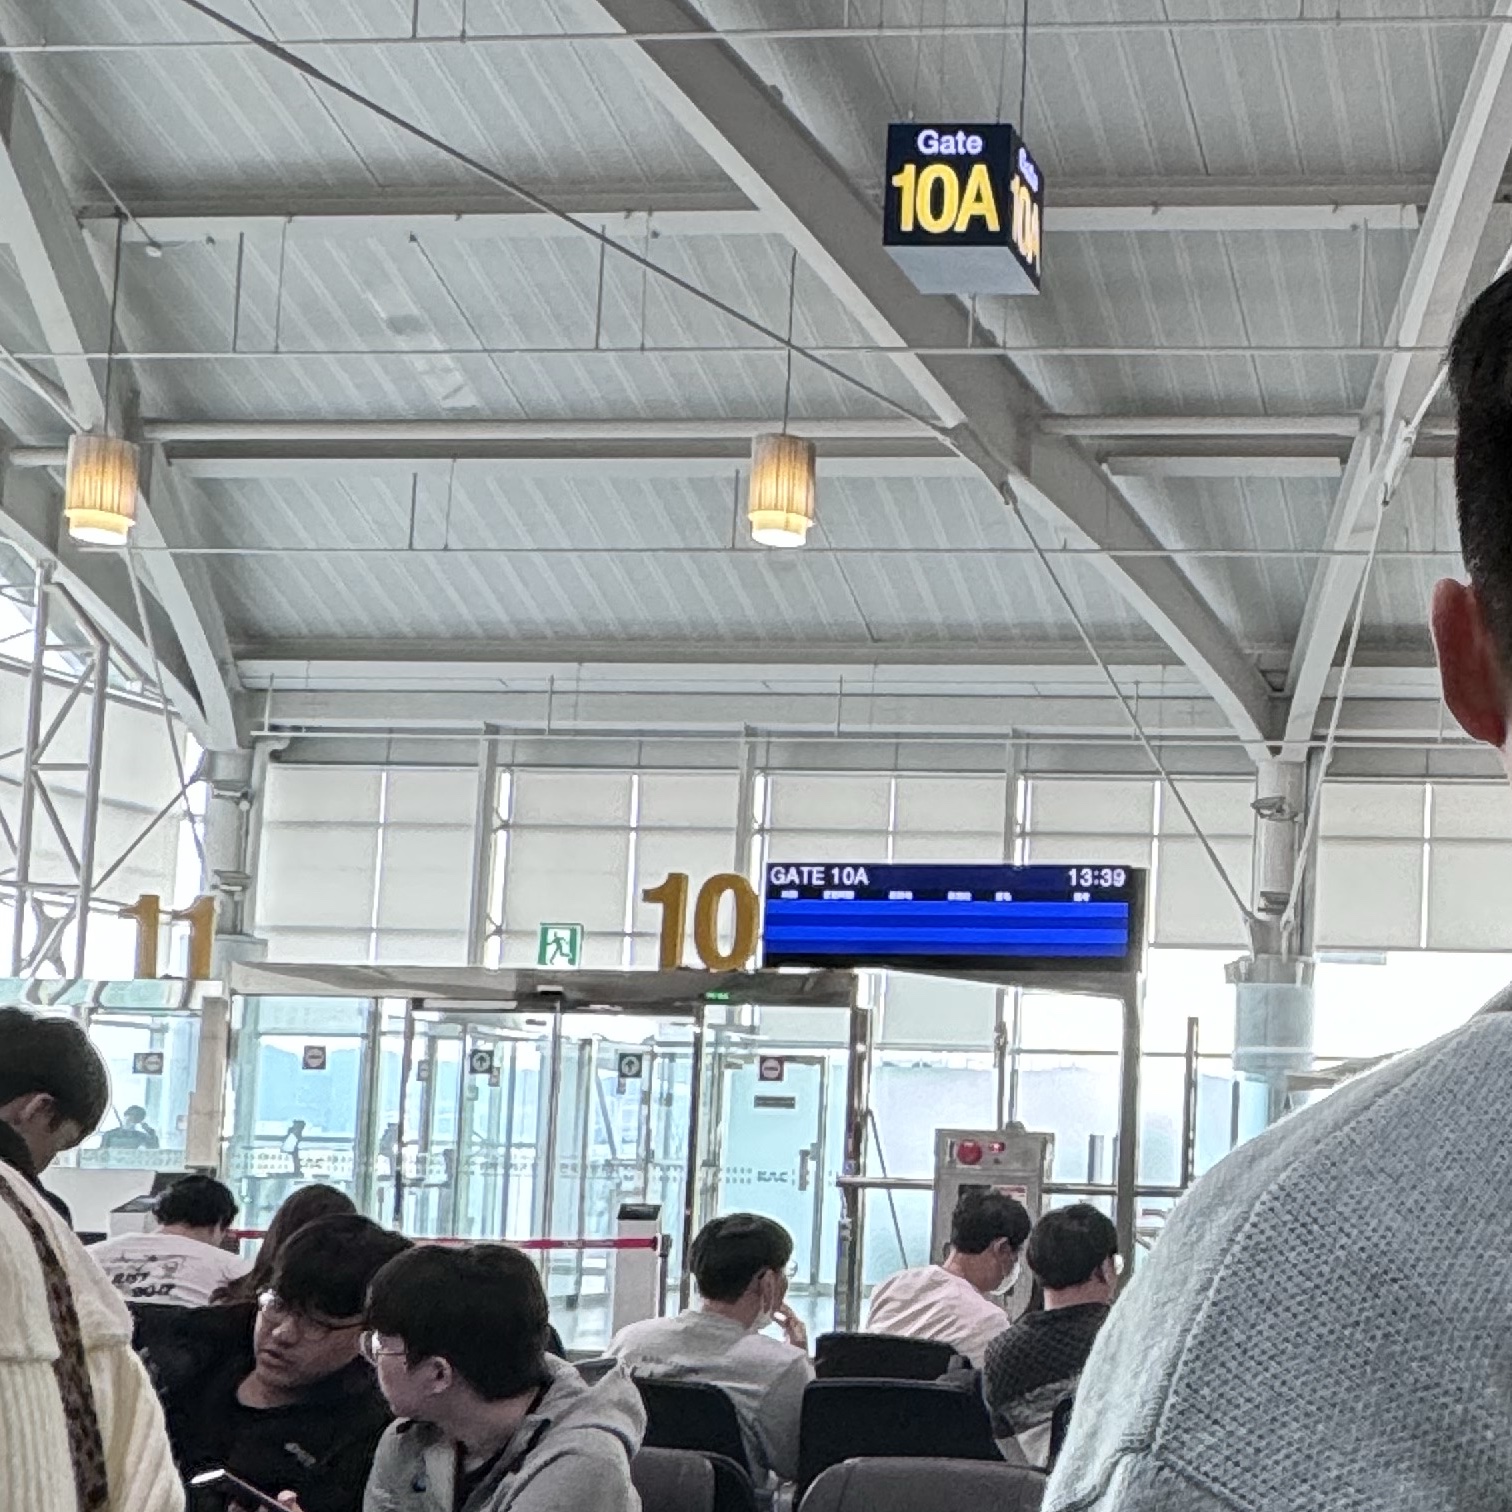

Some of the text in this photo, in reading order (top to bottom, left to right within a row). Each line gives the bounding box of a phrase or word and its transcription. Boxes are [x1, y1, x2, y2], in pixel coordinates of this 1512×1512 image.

[917, 128, 983, 155] Gate
[891, 163, 1001, 234] 10A
[769, 867, 869, 886] GATE 10A
[1069, 868, 1126, 887] 13:39
[119, 894, 216, 980] 11
[643, 872, 761, 972] 10
